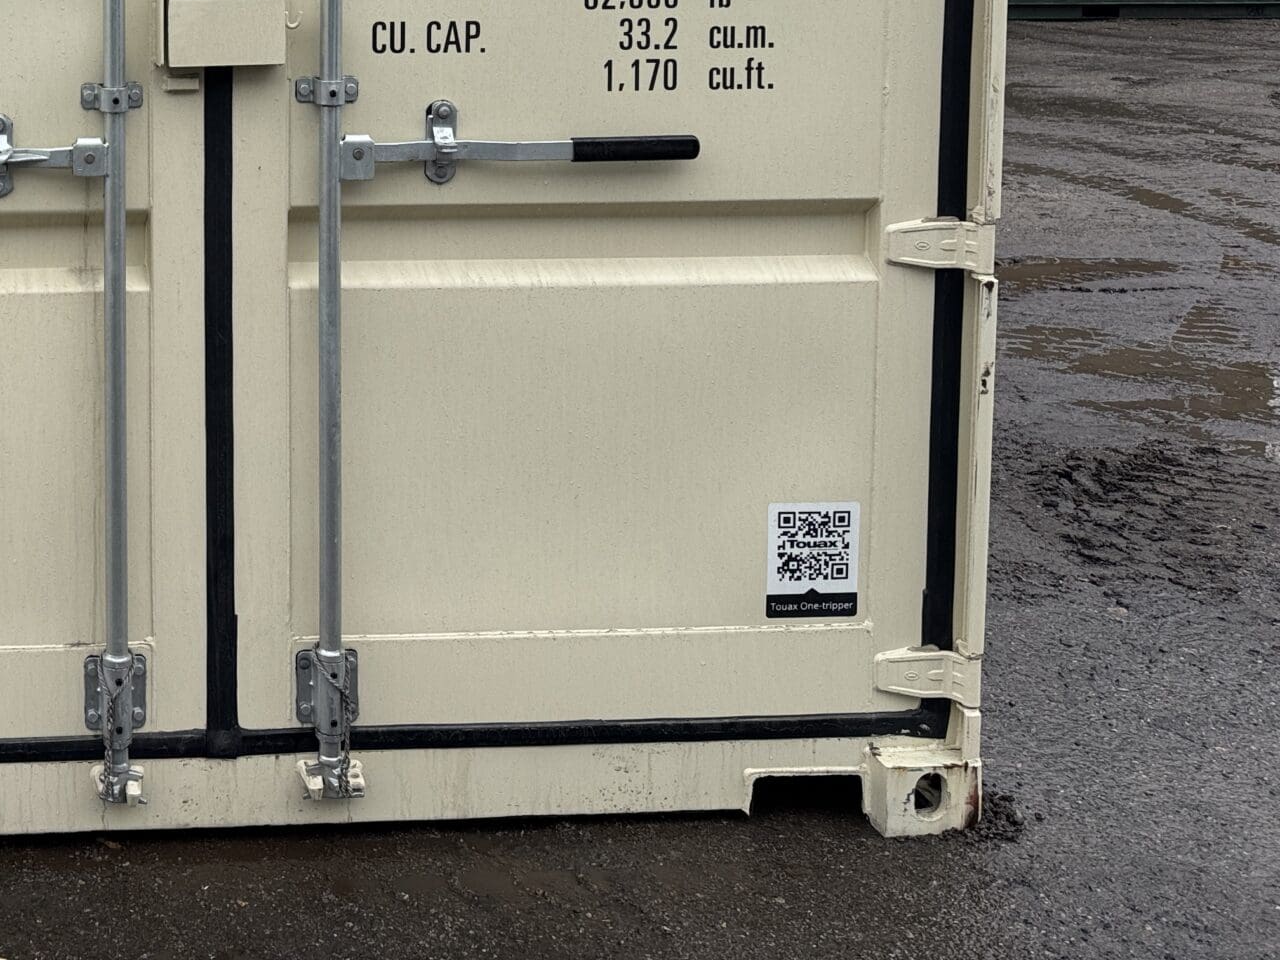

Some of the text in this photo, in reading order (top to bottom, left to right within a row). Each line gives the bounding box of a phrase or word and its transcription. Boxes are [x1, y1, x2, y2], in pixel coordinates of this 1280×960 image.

[371, 17, 775, 54] CU. CAP. 33.2 cu.m.
[604, 58, 775, 92] 1,170 cu.ft.
[787, 540, 838, 549] Touax
[770, 601, 854, 611] Touax One-tripper
